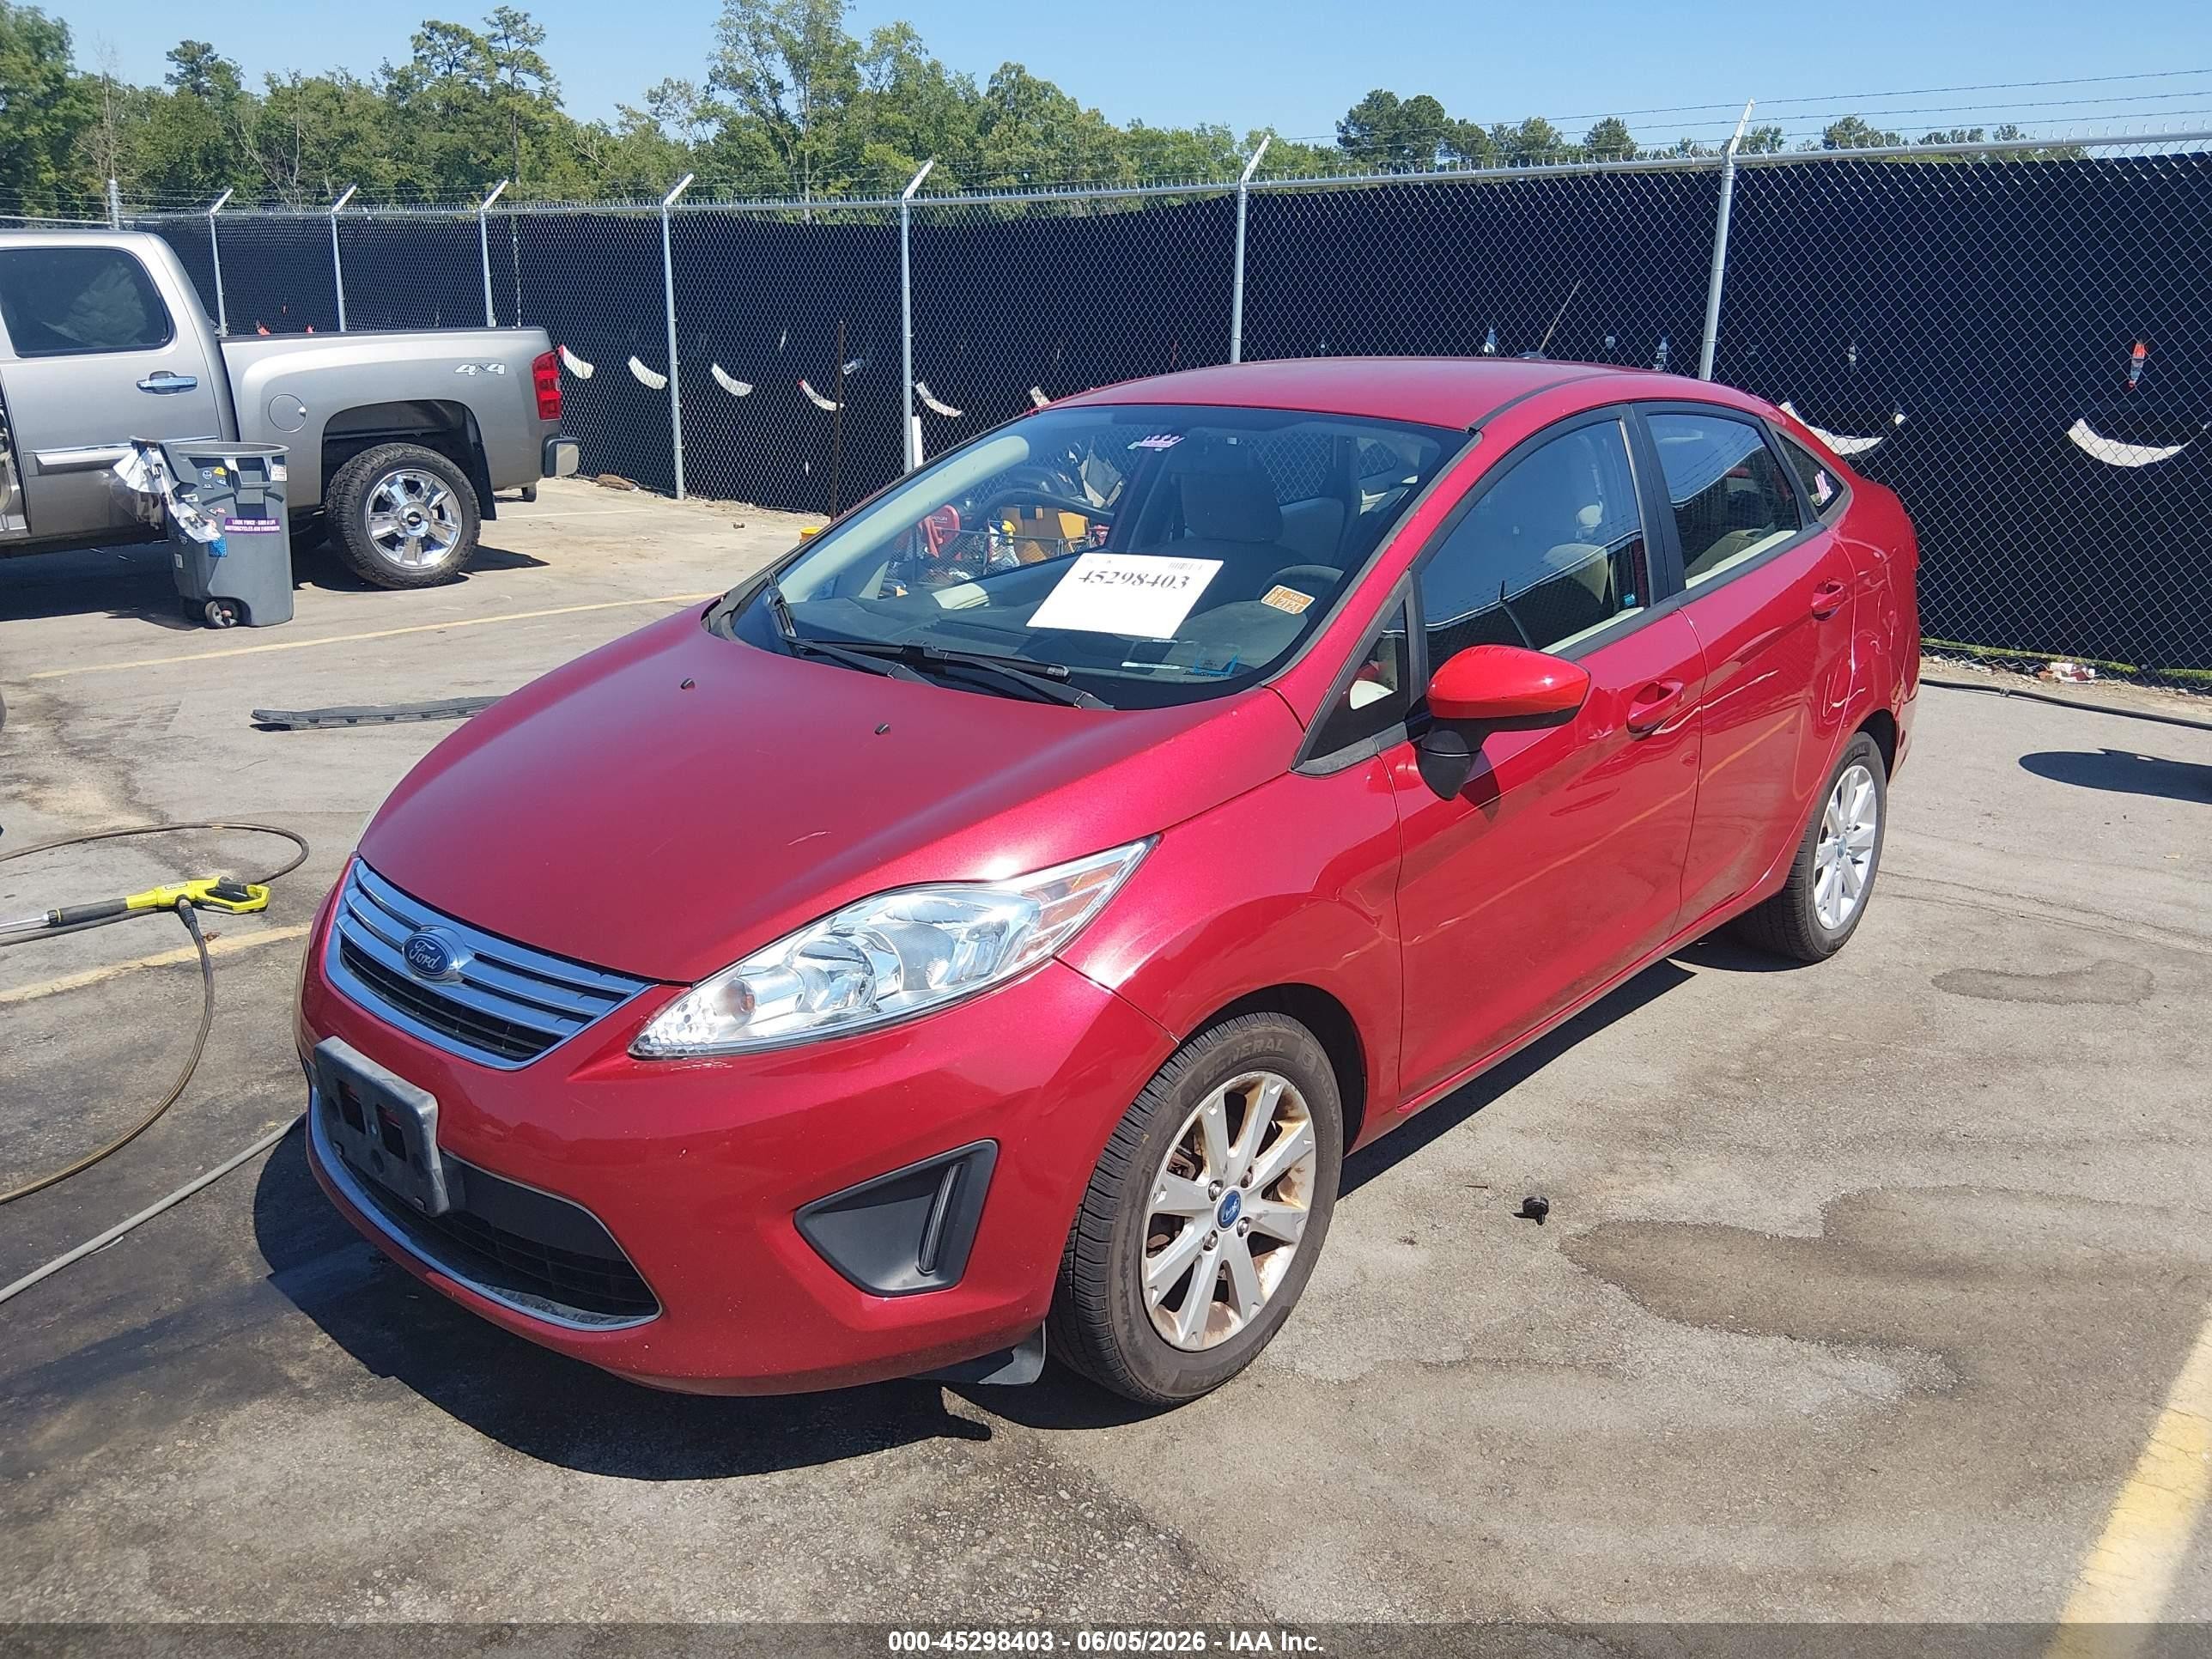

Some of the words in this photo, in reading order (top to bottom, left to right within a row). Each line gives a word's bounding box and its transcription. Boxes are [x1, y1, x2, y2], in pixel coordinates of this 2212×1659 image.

[1079, 569, 1190, 590] 45298403
[409, 940, 441, 969] Ford
[1203, 1038, 1285, 1085] GENERAL
